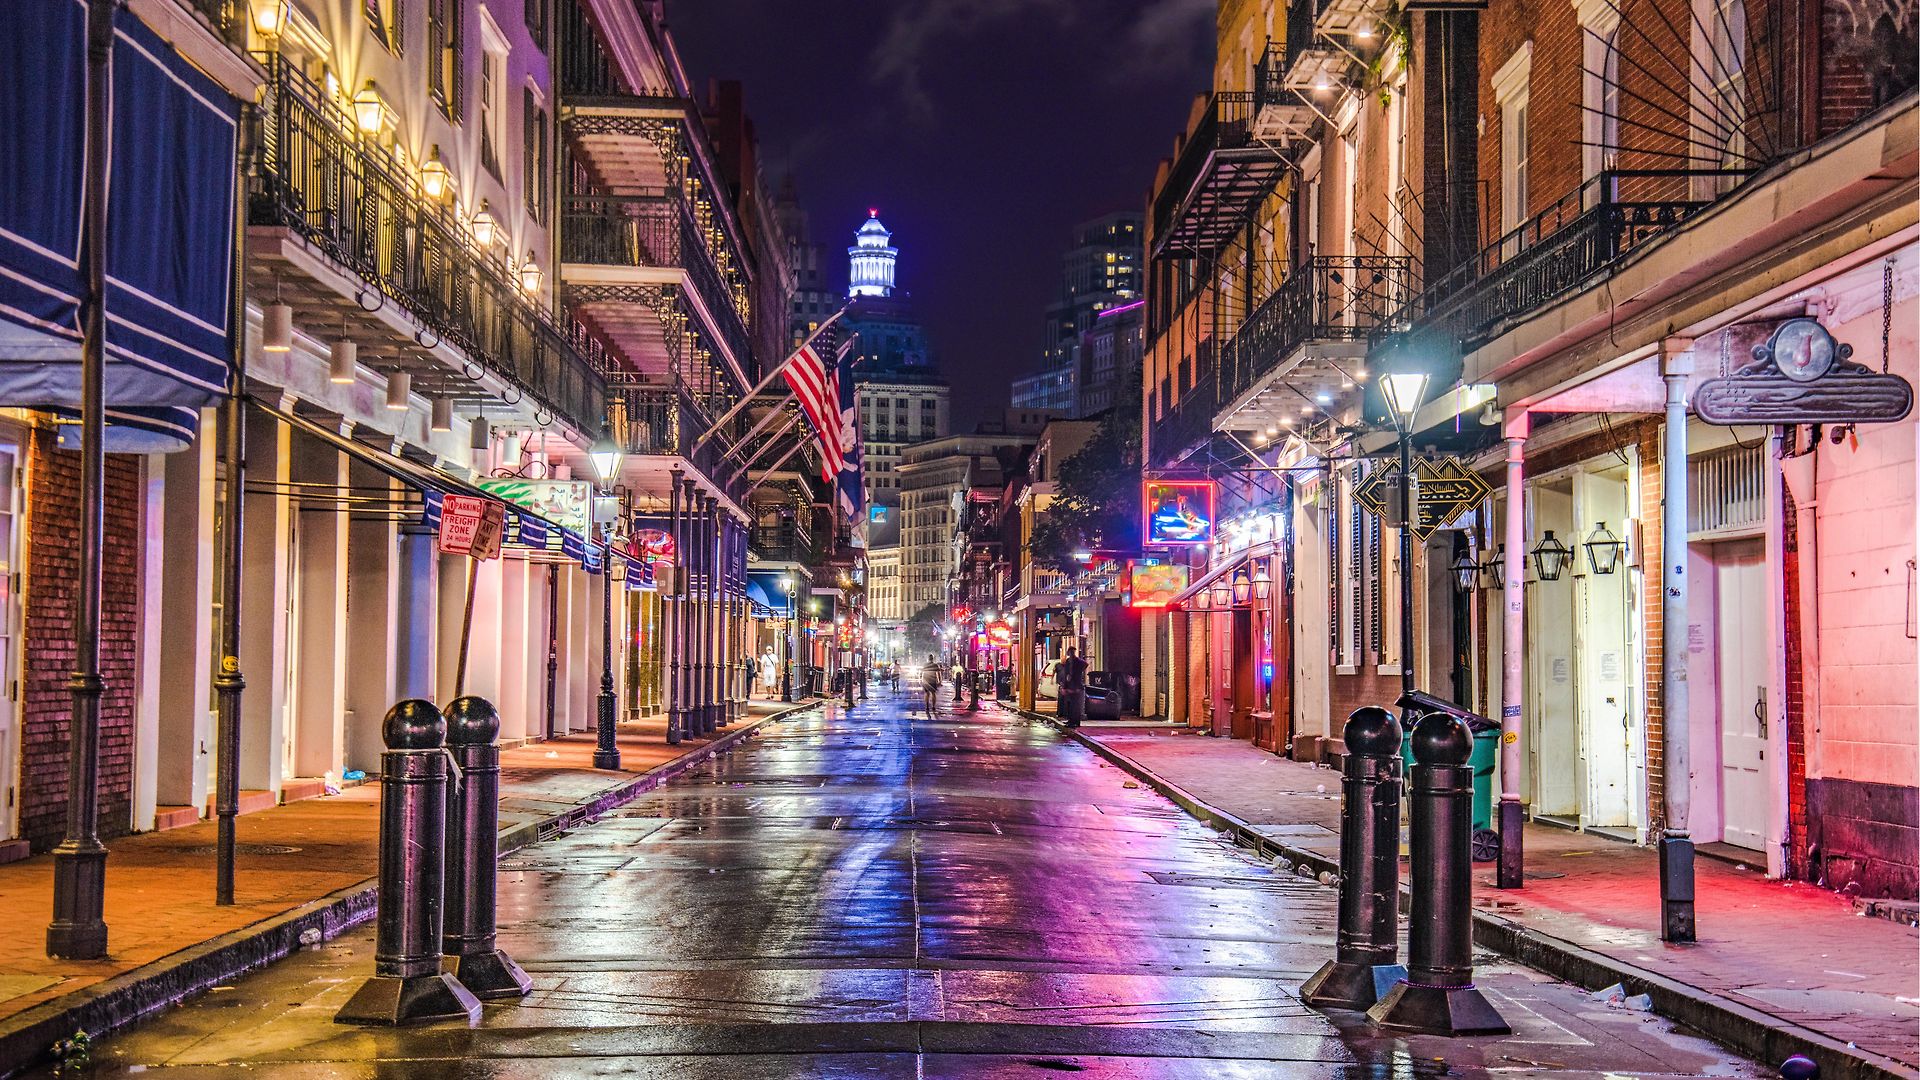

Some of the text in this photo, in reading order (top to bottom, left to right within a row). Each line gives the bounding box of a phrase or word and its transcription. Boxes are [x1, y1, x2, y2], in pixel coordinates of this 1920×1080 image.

[443, 499, 455, 511] NO
[455, 502, 481, 513] PARKING
[445, 516, 477, 527] FREIGHT
[449, 525, 470, 535] ZONE
[482, 522, 494, 535] ANY
[455, 535, 471, 544] HOURS
